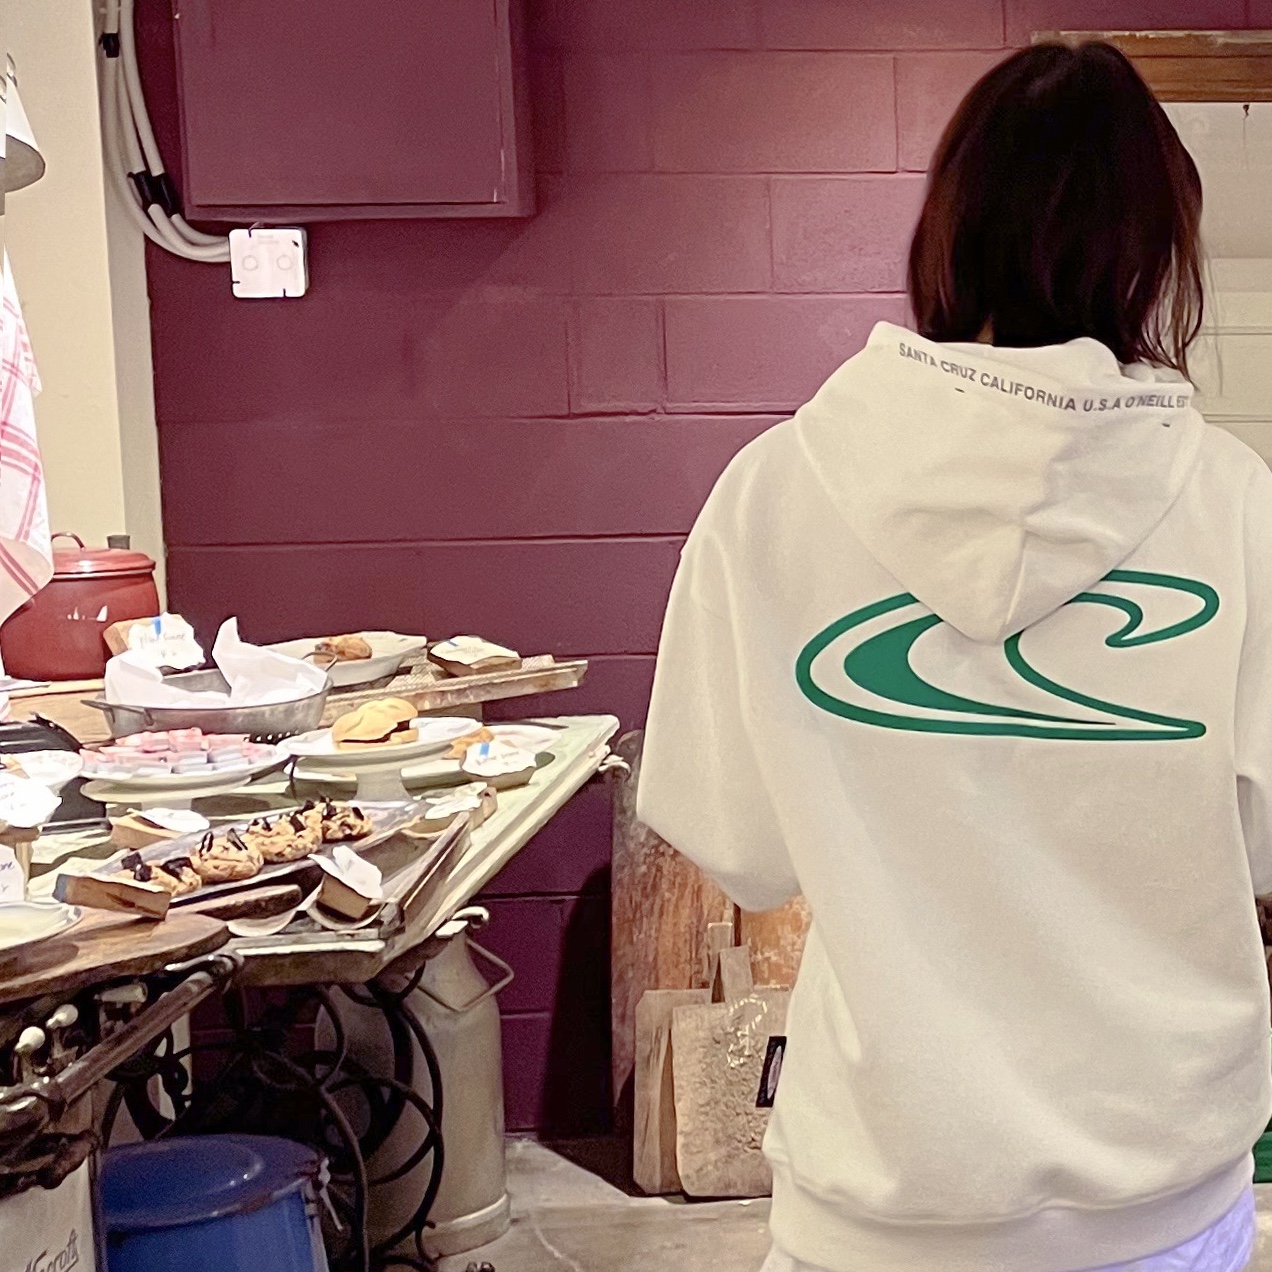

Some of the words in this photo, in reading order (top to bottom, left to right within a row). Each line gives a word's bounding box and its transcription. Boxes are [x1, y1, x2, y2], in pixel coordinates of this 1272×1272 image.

[899, 342, 938, 367] SANTA
[940, 360, 977, 382] CRUZ
[980, 372, 1077, 412] CALIFORNIA
[1125, 394, 1175, 409] O'NEILL
